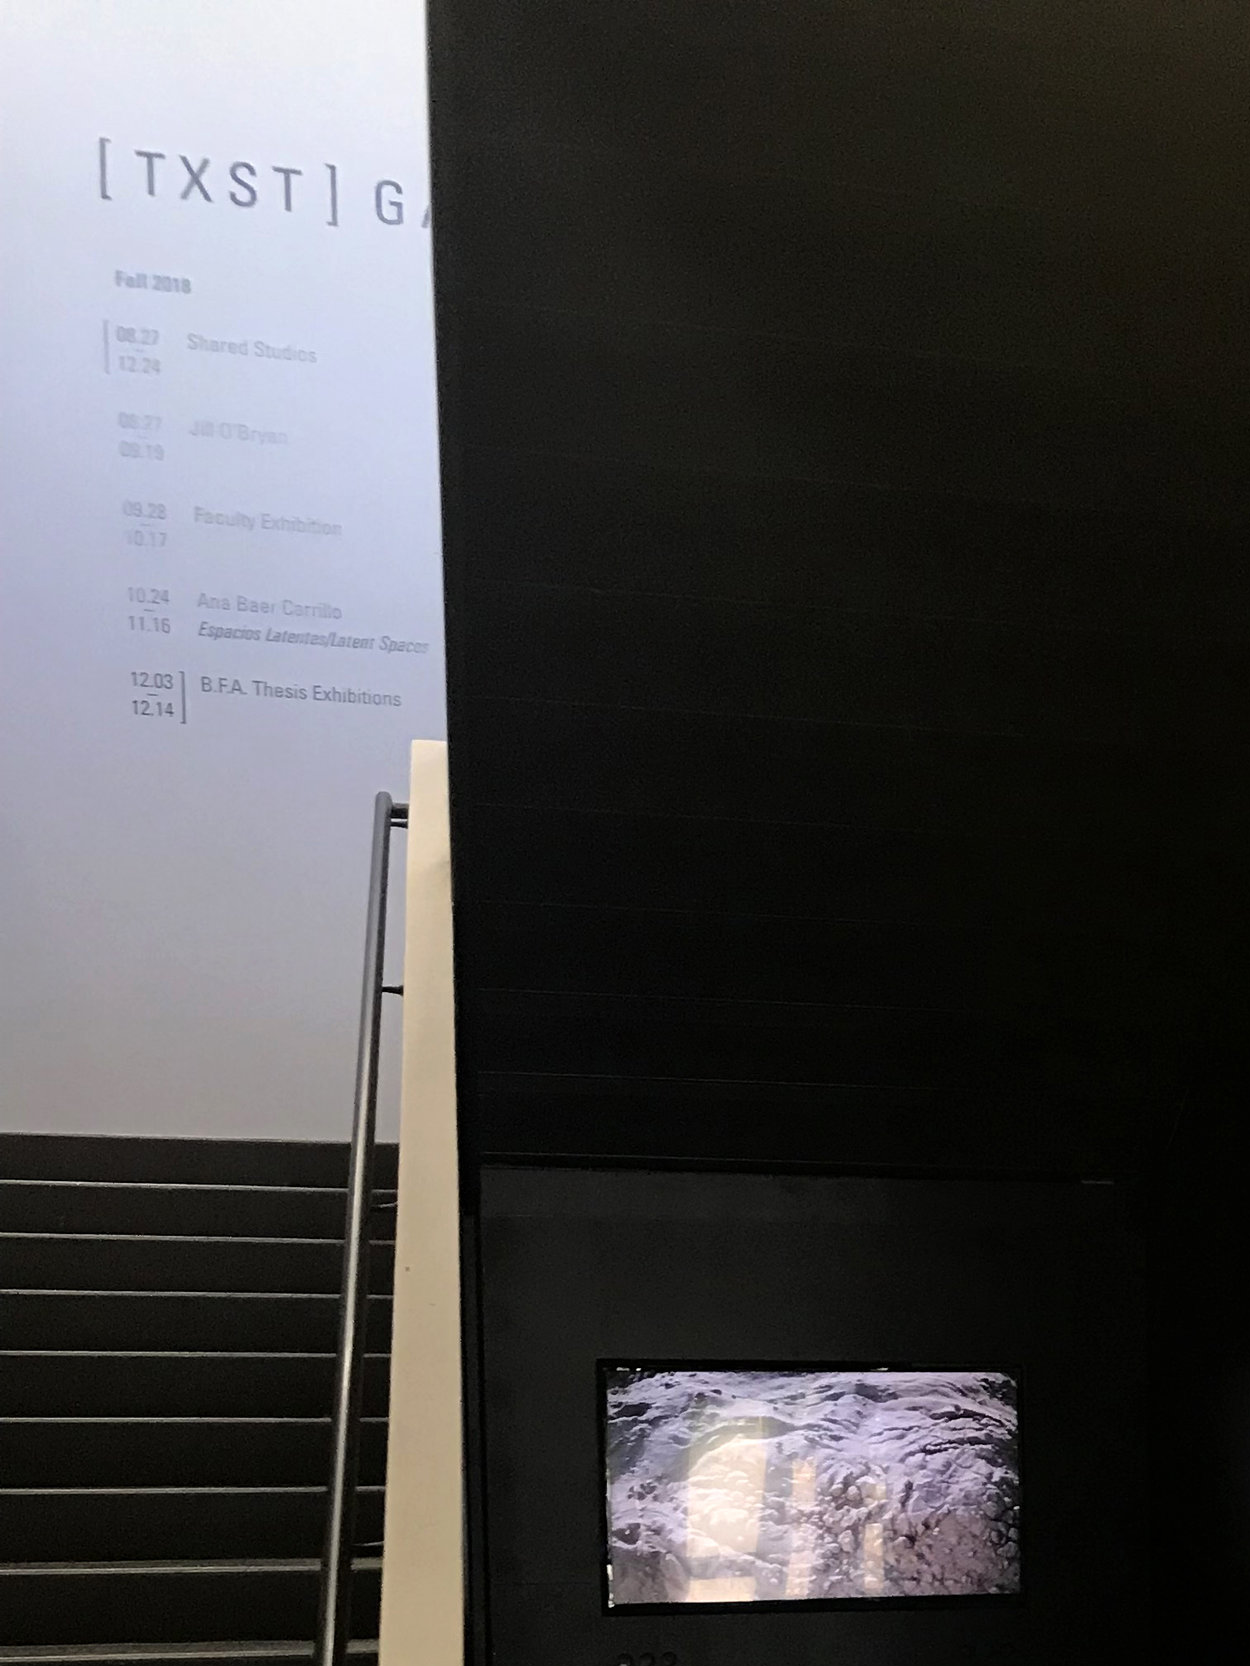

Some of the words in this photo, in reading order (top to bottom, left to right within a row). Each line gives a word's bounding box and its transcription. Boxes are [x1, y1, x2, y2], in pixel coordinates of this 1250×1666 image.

[374, 179, 431, 228] G
[113, 269, 148, 289] Fall
[152, 273, 192, 294] 2018
[186, 332, 249, 356] Shared
[253, 340, 318, 363] Studios
[193, 506, 255, 532] Faculty
[260, 513, 343, 537] Exhibition
[127, 587, 170, 605] 10.24
[197, 592, 231, 611] Ana
[236, 596, 276, 614] Baer
[282, 599, 343, 620] Carrillo
[127, 615, 171, 634] 11.16
[198, 621, 261, 643] Espacios
[378, 635, 430, 654] Spaces
[130, 672, 174, 690] 12.03
[200, 676, 248, 696] B.F.A.
[252, 680, 308, 701] Thesis
[312, 685, 403, 708] Exhibitions
[131, 700, 175, 718] 12.14
